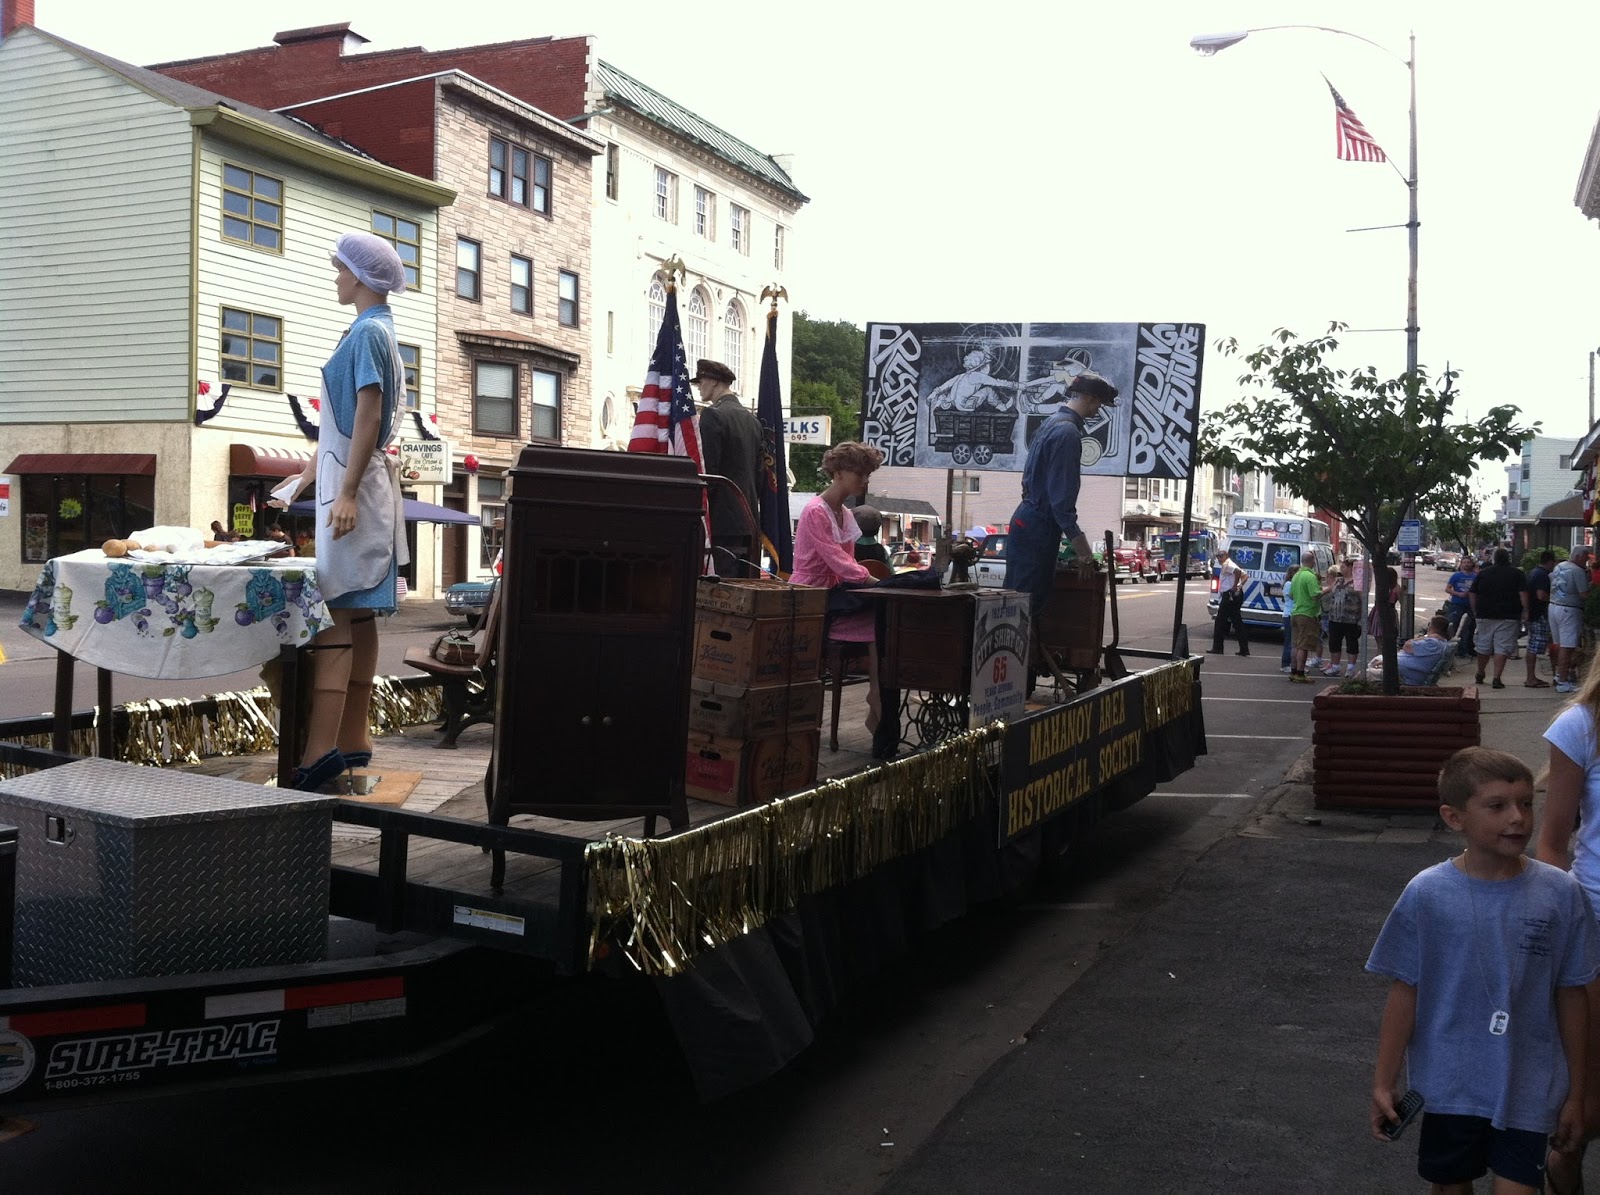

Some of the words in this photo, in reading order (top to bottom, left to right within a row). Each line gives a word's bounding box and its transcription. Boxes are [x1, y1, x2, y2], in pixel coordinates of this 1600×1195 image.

[1128, 323, 1178, 474] BUILDING
[1163, 323, 1199, 434] FUTURE
[402, 444, 442, 452] CRAVINGS
[783, 421, 819, 433] ELKS
[1155, 421, 1190, 478] THE
[976, 635, 992, 669] CITY
[994, 628, 1014, 650] SHIRT
[993, 655, 1008, 684] 65
[1029, 701, 1094, 766] MAHANOY
[1098, 688, 1126, 735] AREA
[1007, 758, 1091, 837] HISTORICAL
[1098, 728, 1141, 784] SOCIETY
[44, 1070, 141, 1091] 1-800-372-1755
